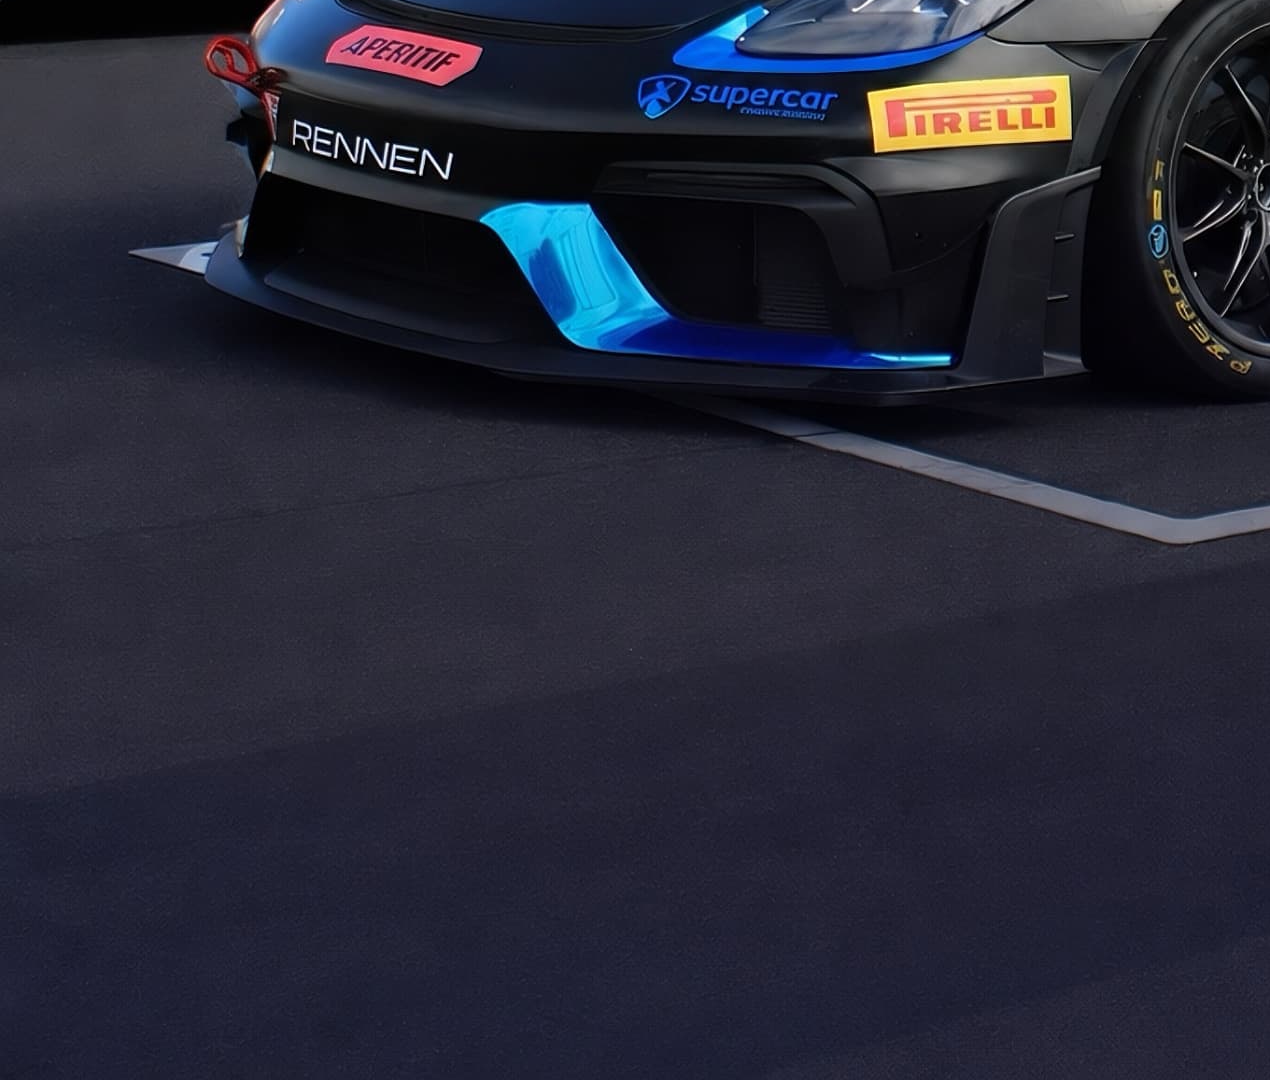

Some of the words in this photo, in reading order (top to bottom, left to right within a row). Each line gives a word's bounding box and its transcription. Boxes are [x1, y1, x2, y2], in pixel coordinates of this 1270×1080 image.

[340, 35, 461, 72] APERITIF
[691, 84, 839, 110] supercar
[885, 89, 1057, 138] PIRELLI
[292, 119, 454, 180] RENNEN
